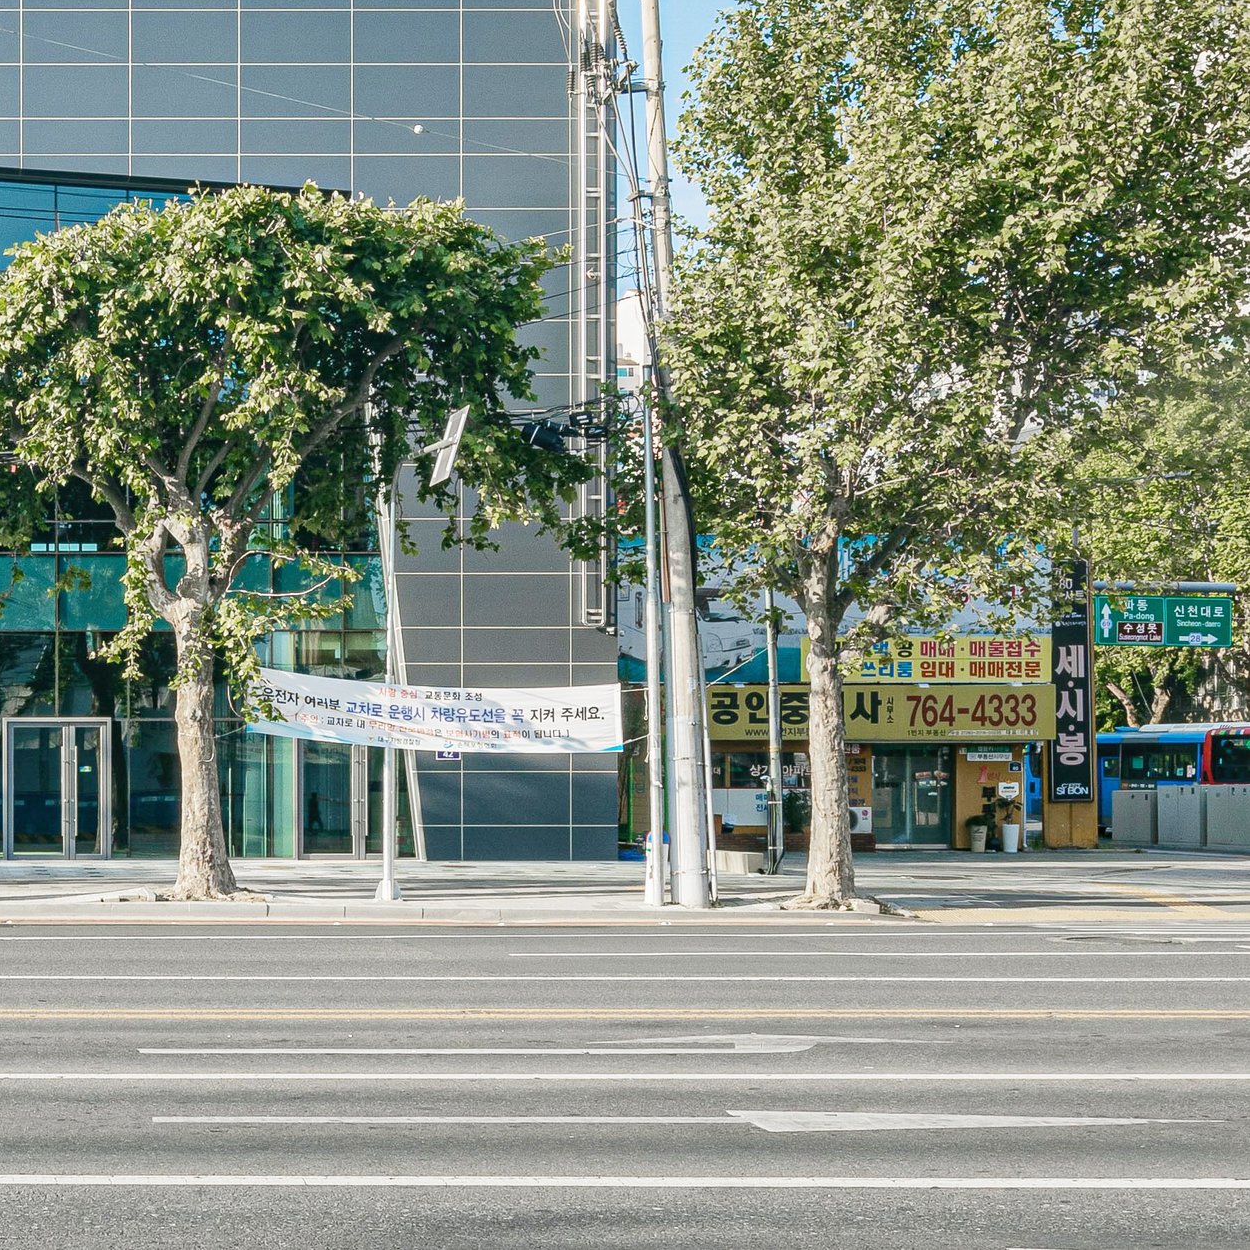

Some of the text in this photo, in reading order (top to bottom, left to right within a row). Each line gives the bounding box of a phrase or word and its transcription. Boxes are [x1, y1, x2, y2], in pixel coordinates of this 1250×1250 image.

[1124, 599, 1148, 611] 파동
[1123, 612, 1154, 622] Pa-dong
[1174, 605, 1225, 618] 신천대로
[1123, 623, 1157, 634] 수성못
[1176, 619, 1221, 627] Sincheon-daero
[1190, 635, 1201, 643] 28
[920, 641, 955, 658] 매매
[969, 641, 1042, 658] 매물접수
[920, 661, 955, 678] 임대
[969, 661, 1042, 678] 매매전문
[400, 688, 418, 699] 중심
[424, 690, 461, 700] 교통문화
[465, 691, 483, 701] 조성
[262, 687, 605, 724] 운전자 여러분 교차로 운행시 차량유도선을 꼭 지켜 주세요.
[711, 691, 882, 725] 공인중사
[906, 693, 1037, 727] 764-4333
[327, 716, 353, 727] 교차로
[357, 720, 365, 729] 내
[926, 729, 946, 737] 부동산
[1067, 786, 1089, 795] BON
